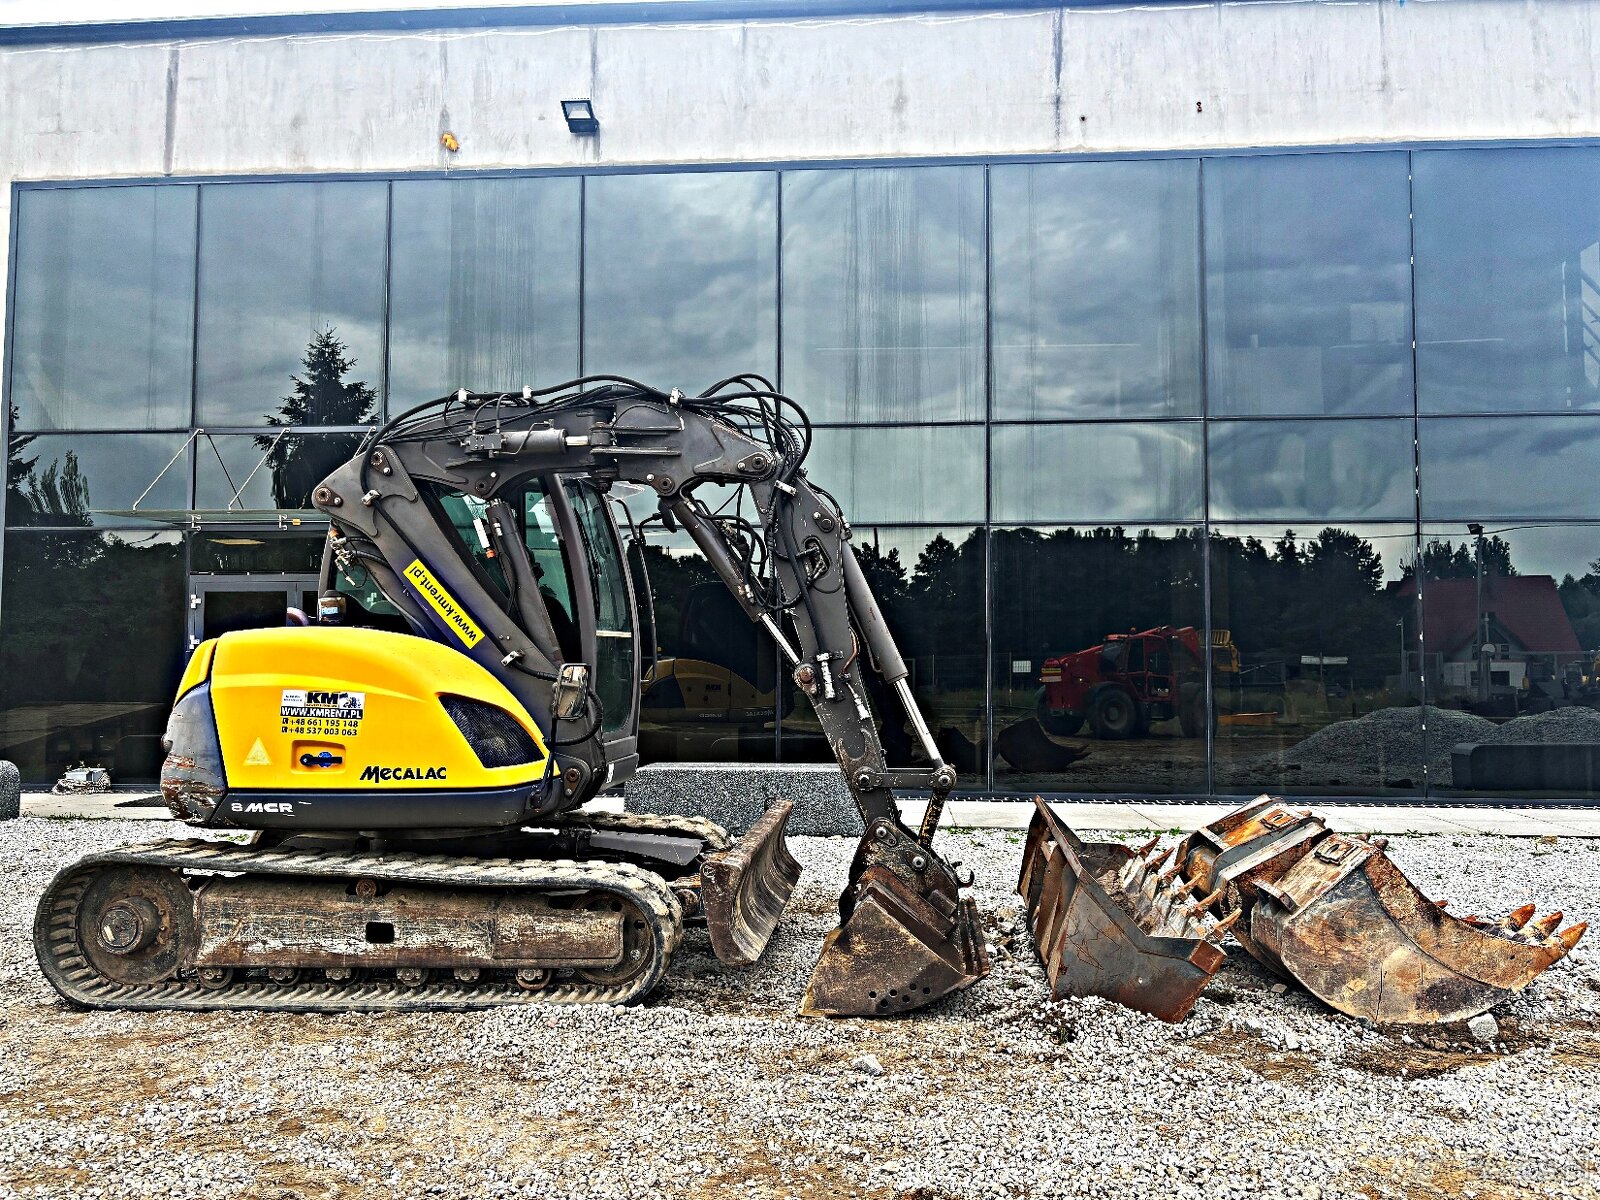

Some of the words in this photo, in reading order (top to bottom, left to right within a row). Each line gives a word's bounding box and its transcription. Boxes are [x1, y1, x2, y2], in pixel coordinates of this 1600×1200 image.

[409, 566, 477, 641] www.kmrent.pl
[307, 692, 339, 704] KM
[281, 706, 362, 719] WWW.KMRENT.PL
[291, 718, 305, 726] +48
[325, 719, 340, 727] 195
[343, 720, 359, 728] 148
[306, 727, 322, 735] 537
[342, 728, 357, 736] 063
